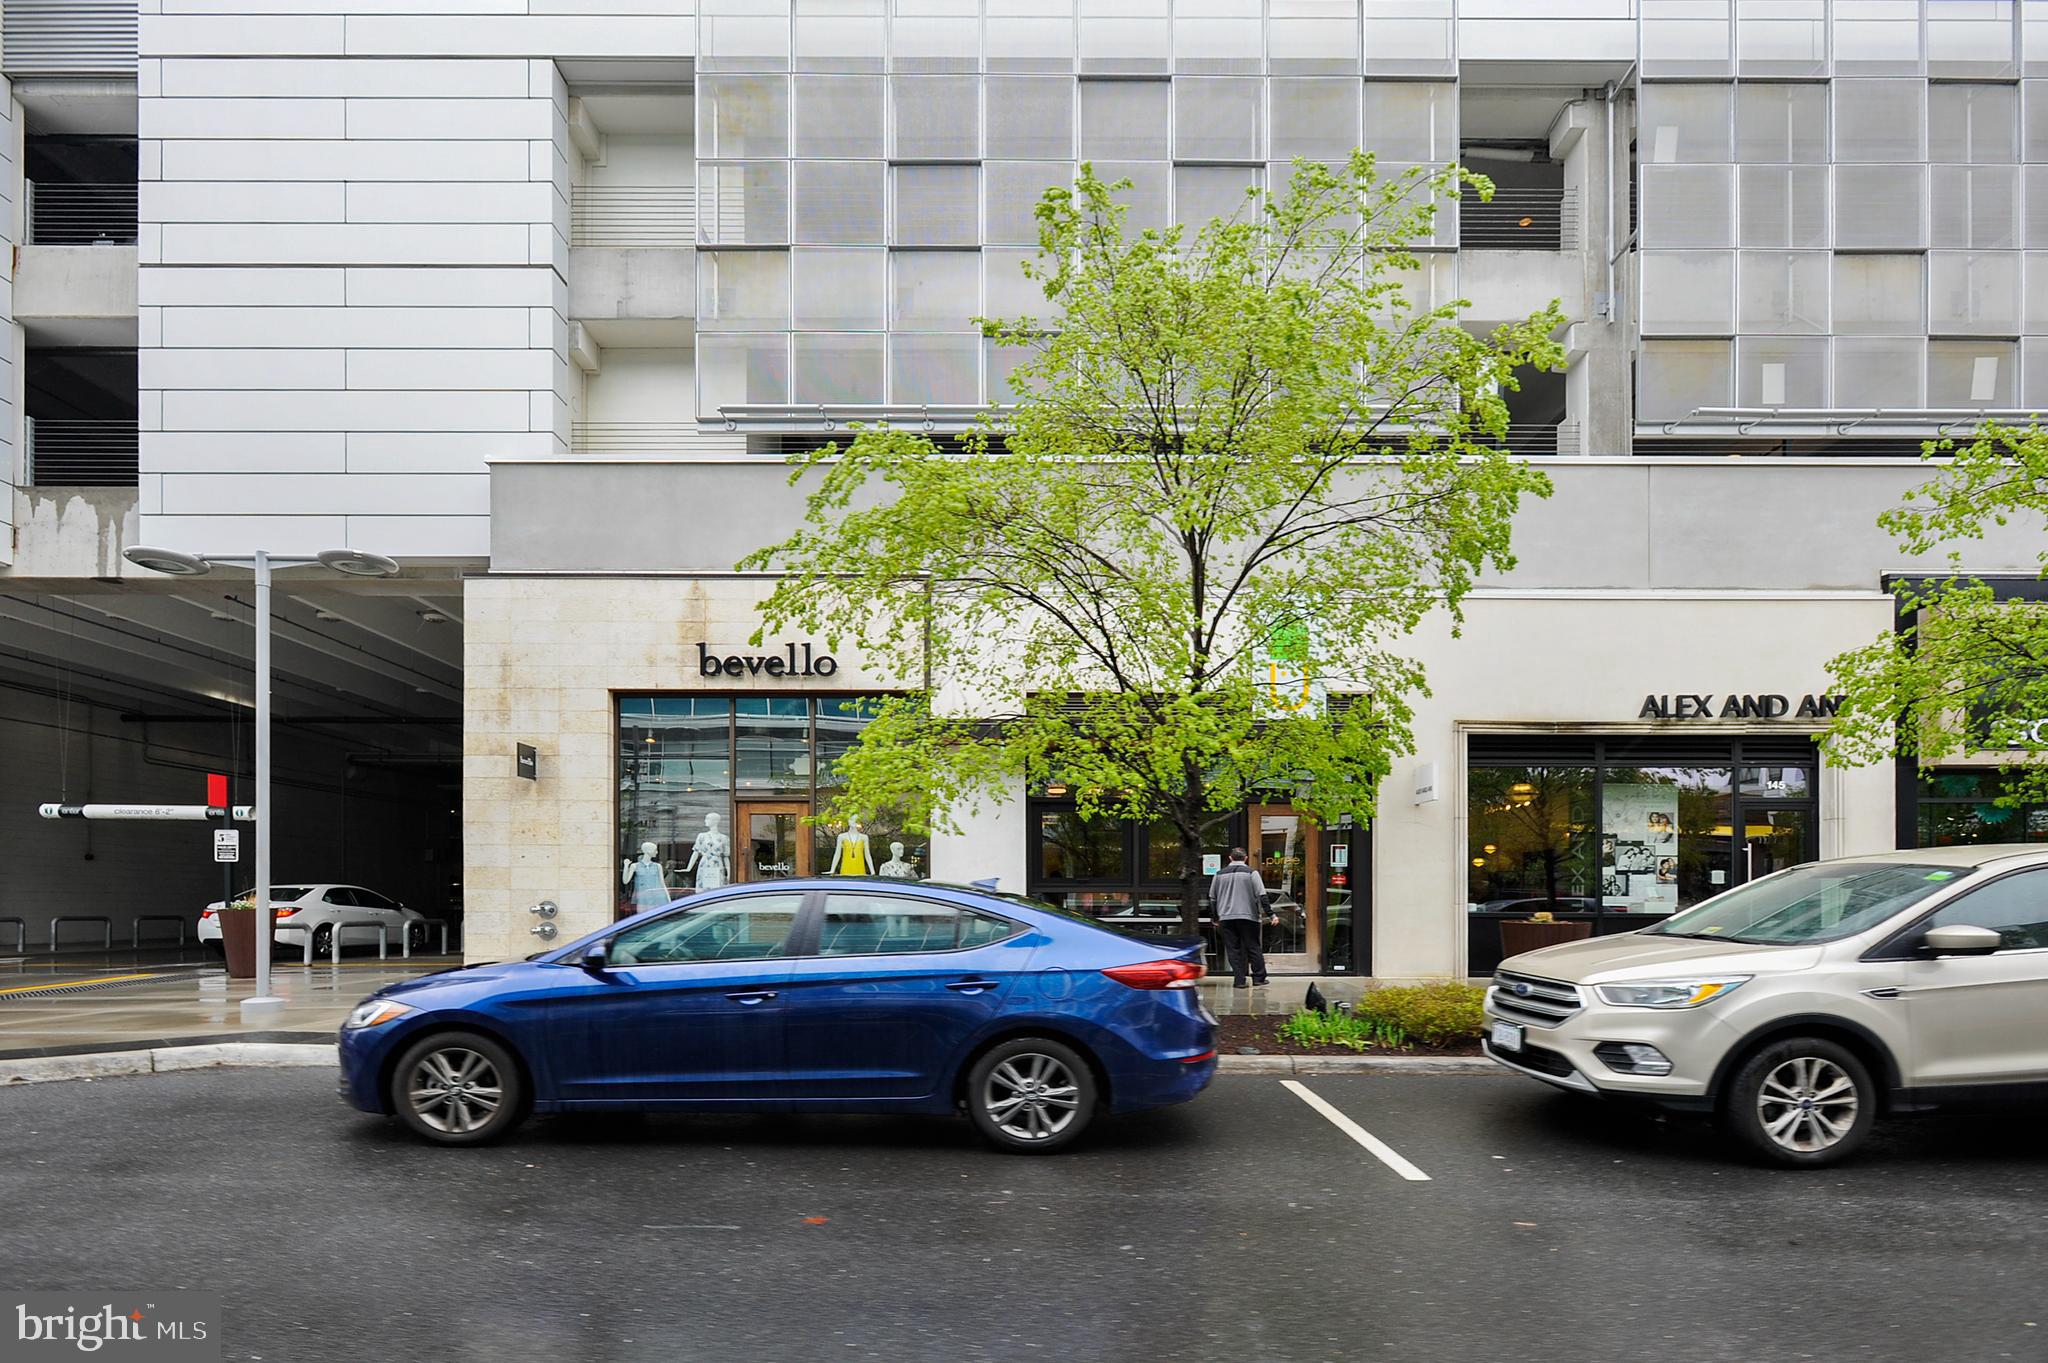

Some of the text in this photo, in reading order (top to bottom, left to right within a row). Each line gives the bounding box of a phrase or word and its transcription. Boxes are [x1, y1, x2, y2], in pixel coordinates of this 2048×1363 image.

[696, 642, 838, 677] bevello
[1638, 694, 1850, 718] ALEX AND AN
[1766, 780, 1787, 790] 145
[758, 861, 790, 871] bevello
